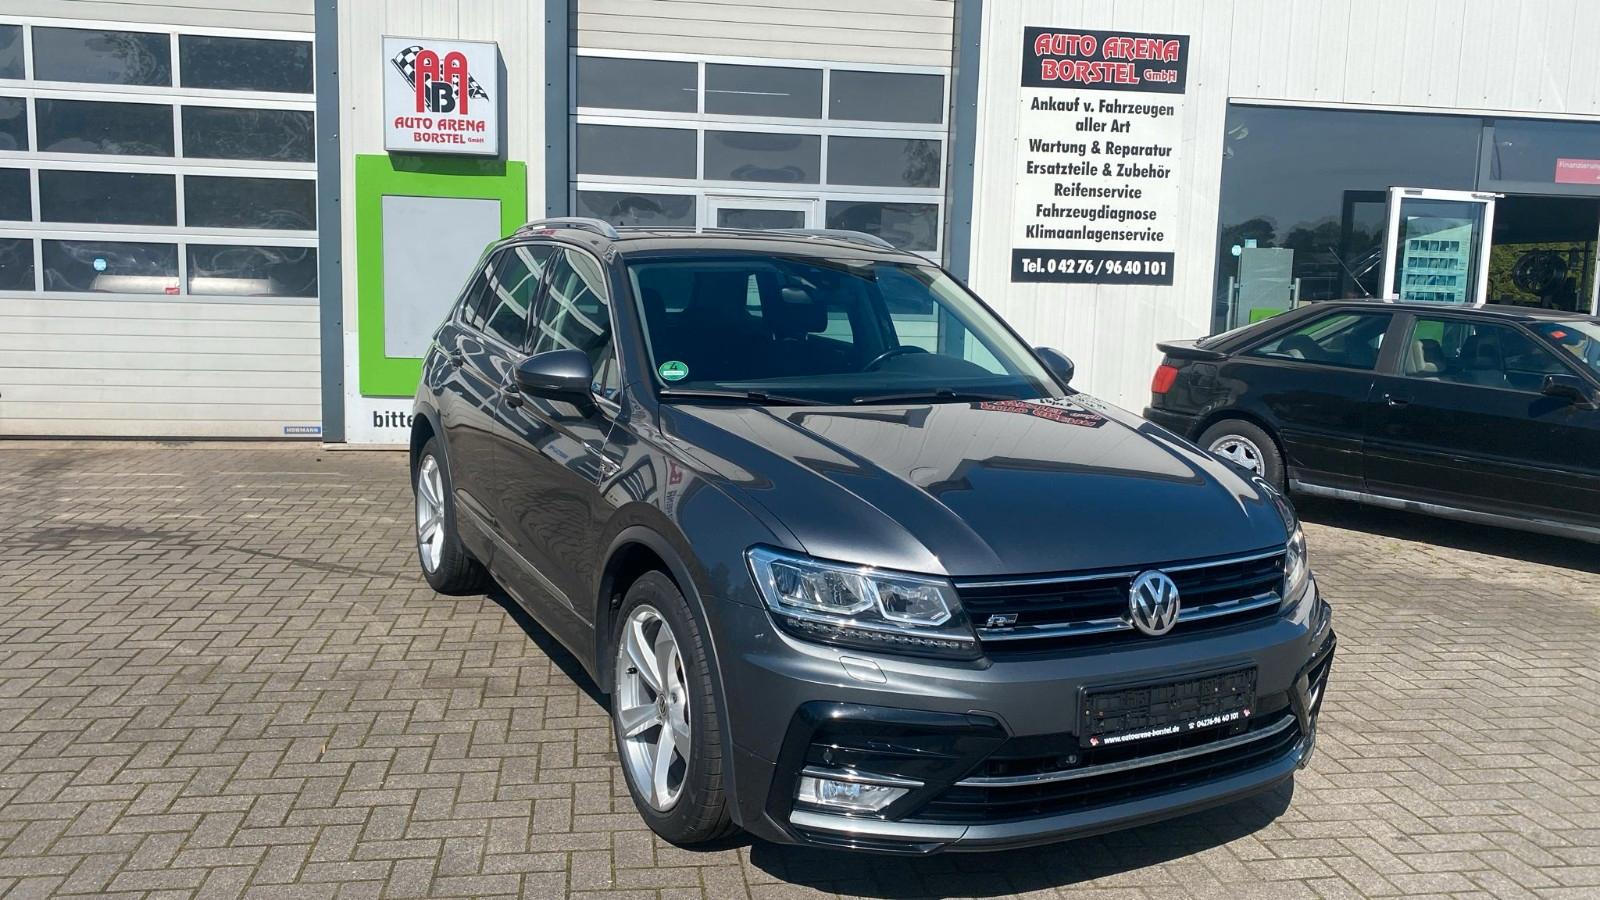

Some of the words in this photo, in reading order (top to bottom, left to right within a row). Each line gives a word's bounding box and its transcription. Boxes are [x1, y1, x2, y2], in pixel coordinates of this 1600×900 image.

[1034, 32, 1097, 57] AUTO
[1103, 36, 1180, 63] ARENA
[1041, 58, 1139, 85] BORSTEL
[1143, 68, 1177, 83] GmbH
[1030, 96, 1080, 112] Ankauf
[1083, 102, 1095, 113] v.
[1098, 98, 1175, 118] Fahrzeugen
[394, 117, 433, 129] AUTO
[437, 119, 486, 133] ARENA
[1075, 117, 1107, 132] aller
[1110, 119, 1131, 133] Art
[413, 132, 466, 144] BORSTEL
[1029, 138, 1086, 156] Wartung
[1091, 140, 1101, 155] &
[1105, 141, 1172, 158] Reparatur
[1026, 160, 1098, 176] Ersatzteile
[1102, 162, 1112, 177] &
[1116, 163, 1171, 179] Zubehör
[1054, 182, 1142, 199] Reifenservice
[1035, 202, 1157, 223] Fahrzeugdiagnose
[1025, 224, 1164, 243] Klimaanlagenservice
[1022, 258, 1045, 273] Tel.
[670, 362, 678, 370] 4
